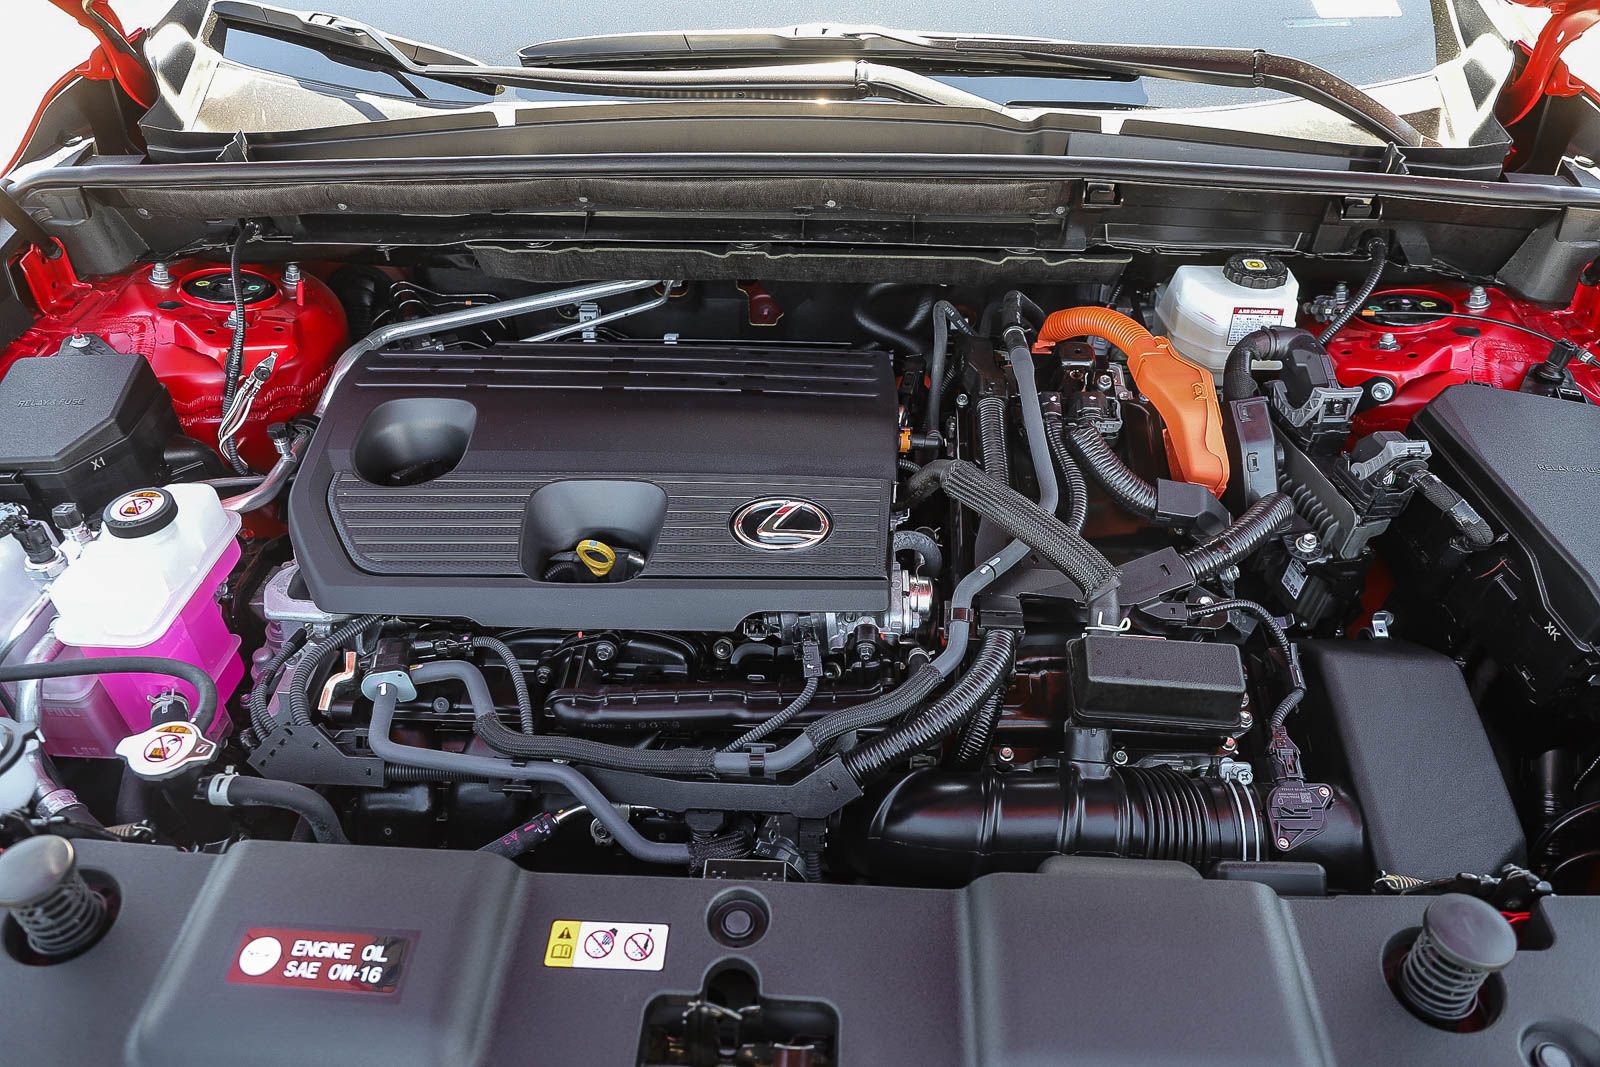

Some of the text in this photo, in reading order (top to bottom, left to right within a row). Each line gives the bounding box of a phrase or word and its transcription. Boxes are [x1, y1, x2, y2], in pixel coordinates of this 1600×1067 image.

[17, 399, 50, 407] RELAY
[90, 456, 106, 471] X1
[1537, 464, 1569, 472] RELAY
[1544, 621, 1561, 642] XK
[290, 939, 388, 963] ENGINE OIL
[283, 960, 383, 984] SAE 0W-16
